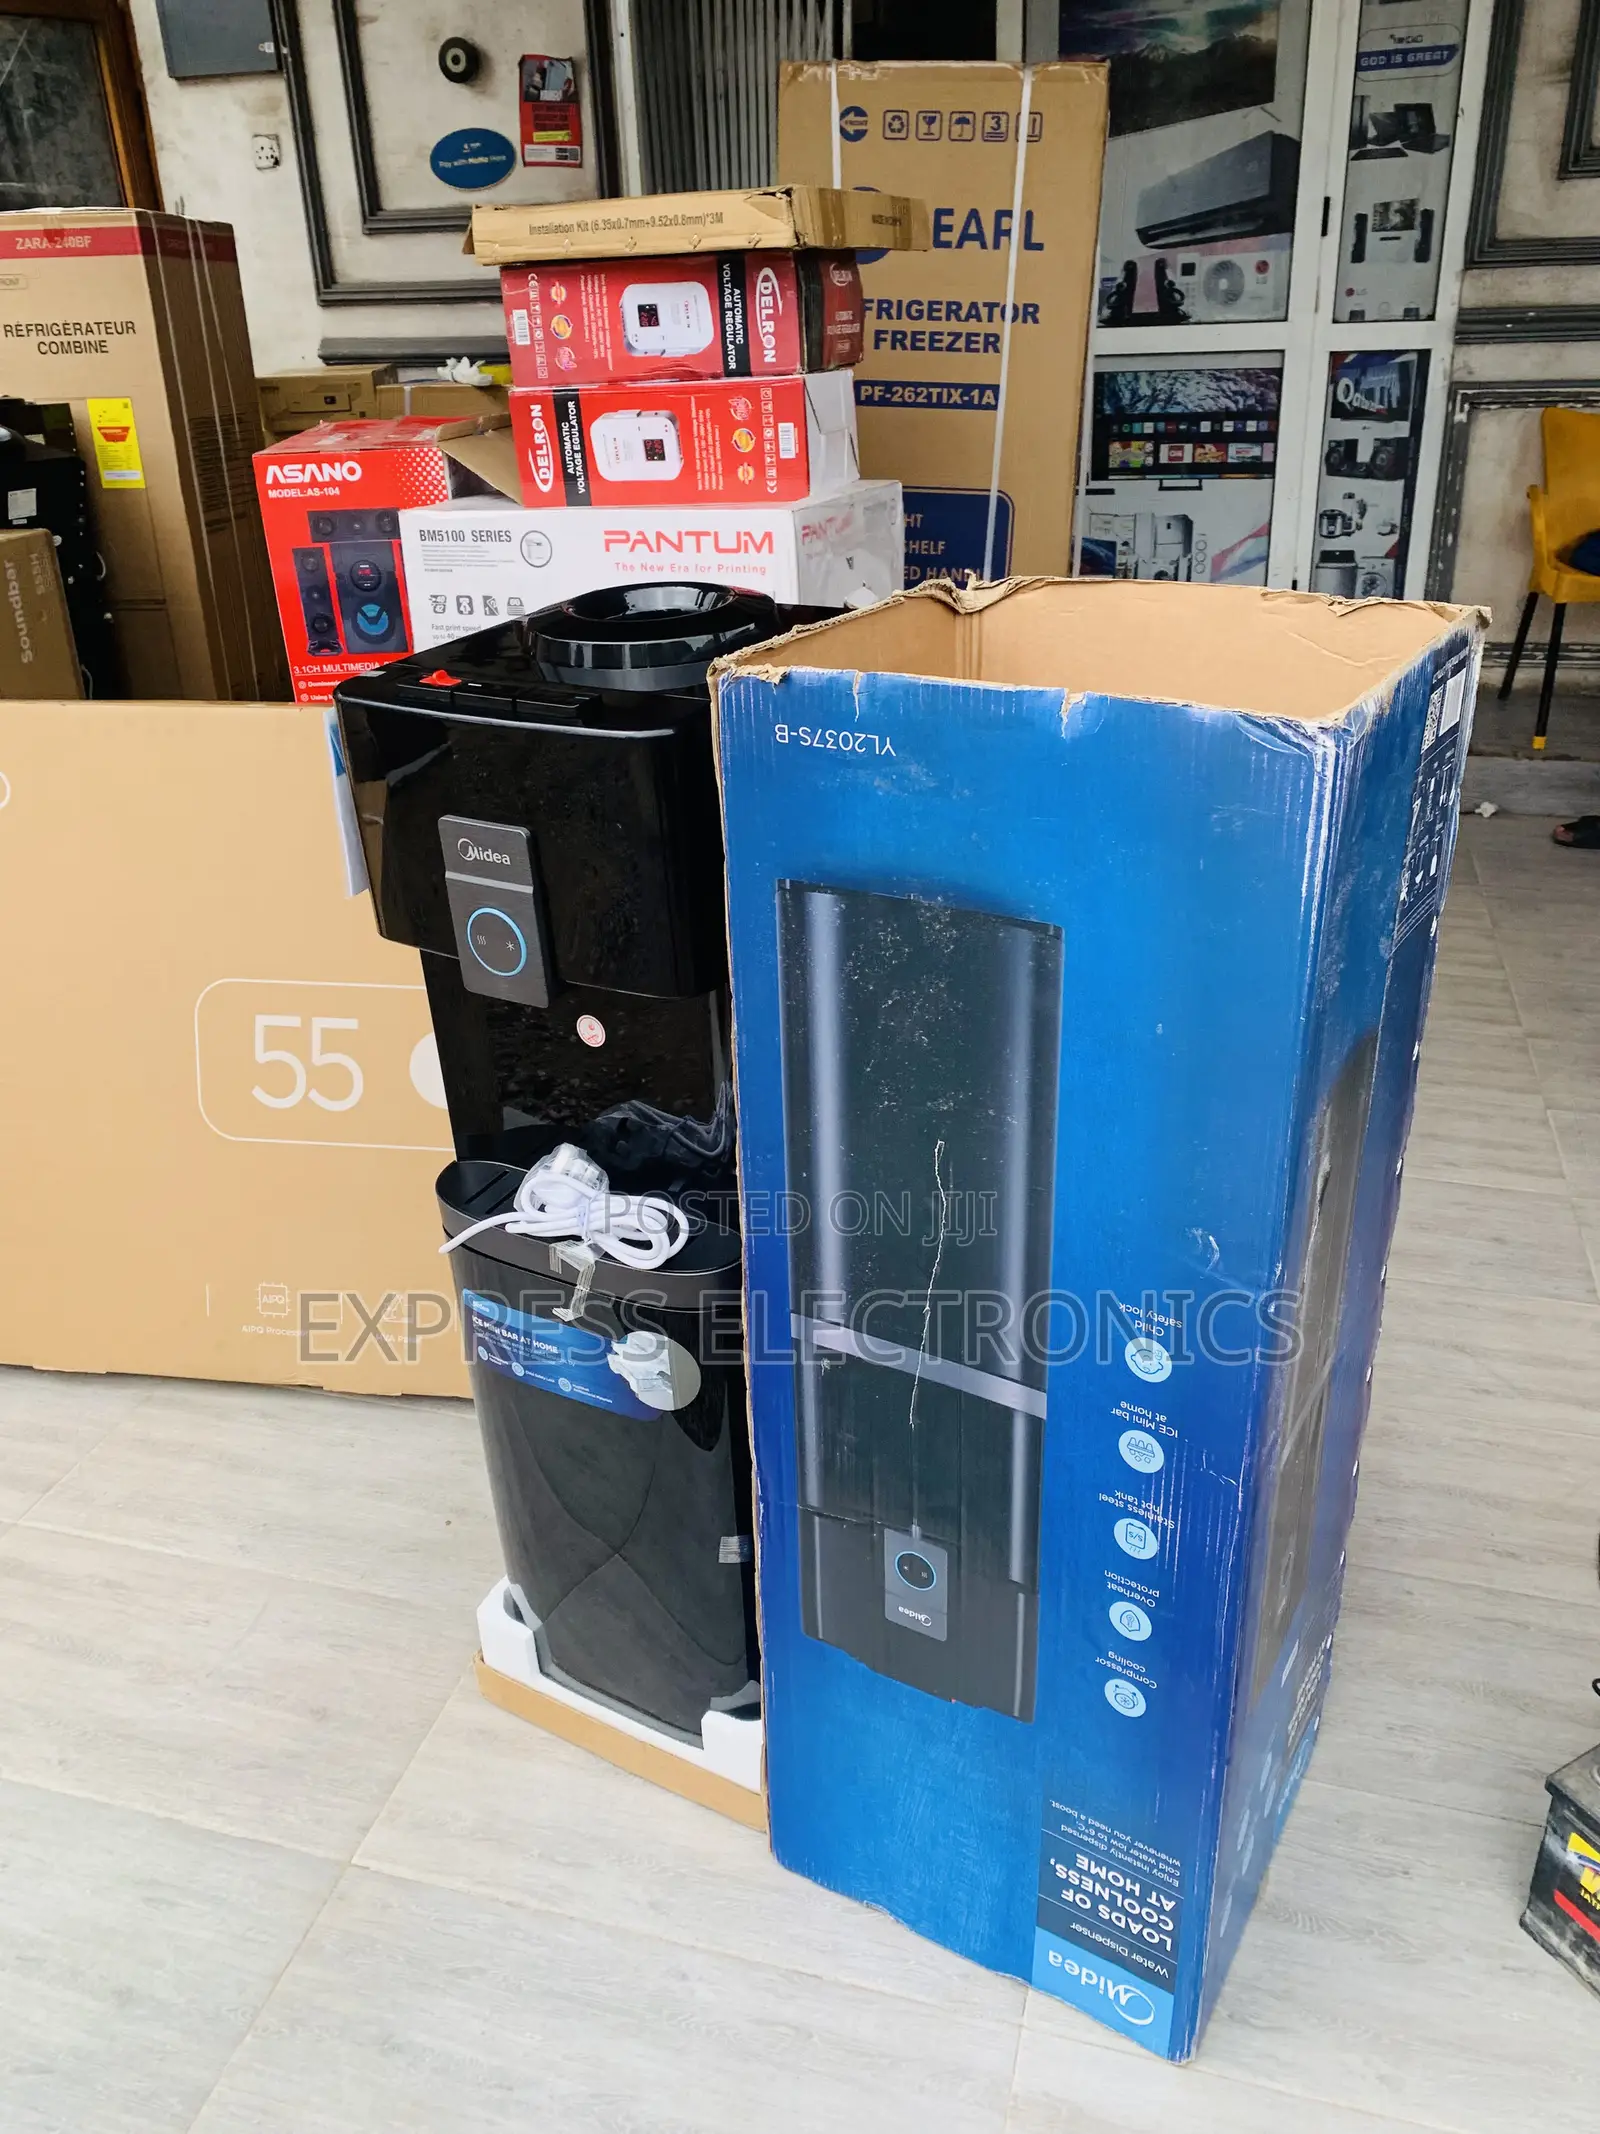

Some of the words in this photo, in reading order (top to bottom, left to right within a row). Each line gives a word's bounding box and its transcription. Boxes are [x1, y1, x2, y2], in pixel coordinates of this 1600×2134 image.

[1361, 55, 1386, 66] GOD
[1390, 54, 1402, 63] IS
[1407, 50, 1450, 62] GREAT
[529, 221, 575, 235] Installation
[576, 220, 589, 232] Kit
[722, 263, 732, 308] VOLTAGE
[733, 288, 744, 345] AUTOMATIC
[760, 281, 776, 363] DELRON
[37, 340, 109, 355] COMBINE
[725, 310, 736, 370] REGULATOR
[874, 329, 1000, 354] FREEZER
[860, 385, 996, 405] PF-262TIX-1A
[530, 404, 549, 479] DELRON
[561, 421, 575, 474] AUTOMATIC
[266, 461, 362, 484] ASANO
[573, 451, 585, 494] VOLTAGE
[268, 488, 340, 498] MODEL:AS-104
[419, 530, 466, 543] BM5100
[471, 530, 512, 543] SERIES
[603, 530, 774, 554] PANTUM
[615, 562, 635, 572] The
[640, 562, 665, 572] New
[671, 563, 690, 572] Era
[695, 562, 712, 573] for
[717, 563, 766, 576] Printing
[4, 560, 33, 664] Soundbar
[293, 665, 320, 674] 3.1CH
[323, 662, 380, 672] MULTIMEDIA
[774, 724, 896, 757] YL2037S-B
[457, 837, 511, 865] Midea
[252, 1014, 364, 1112] 55
[1118, 1302, 1143, 1318] lock
[1146, 1310, 1183, 1328] safety
[1135, 1320, 1165, 1337] Child
[501, 1329, 519, 1341] BAR
[520, 1335, 531, 1345] AT
[532, 1339, 560, 1354] HOME
[1111, 1407, 1129, 1421] bar
[1120, 1400, 1152, 1420] home
[1155, 1412, 1167, 1422] at
[1132, 1415, 1155, 1430] Mini
[1159, 1423, 1179, 1438] ICE
[1098, 1493, 1124, 1508] steel
[1114, 1489, 1138, 1505] tank
[1142, 1500, 1160, 1514] hot
[1127, 1505, 1175, 1529] Stainless
[1104, 1569, 1160, 1598] protection
[1107, 1581, 1156, 1608] Overheat
[898, 1606, 932, 1626] Midea
[1049, 1799, 1078, 1817] boost.
[1088, 1818, 1112, 1833] need
[1061, 1824, 1107, 1851] dispensed
[1097, 1832, 1108, 1842] to
[1110, 1839, 1127, 1852] low
[1113, 1830, 1132, 1843] you
[1110, 1848, 1150, 1874] instantly
[1129, 1848, 1157, 1866] water
[1134, 1841, 1181, 1867] whenever
[1076, 1853, 1141, 1896] HOME
[1152, 1868, 1179, 1888] Enjoy
[1159, 1862, 1180, 1877] cold
[1050, 1858, 1174, 1932] COOLNESS,
[1060, 1888, 1091, 1910] OF
[1146, 1891, 1177, 1912] AT
[1098, 1905, 1172, 1951] LOADS
[1069, 1922, 1129, 1958] Dispenser
[1131, 1952, 1169, 1979] Water
[1048, 1950, 1156, 2025] Midea
